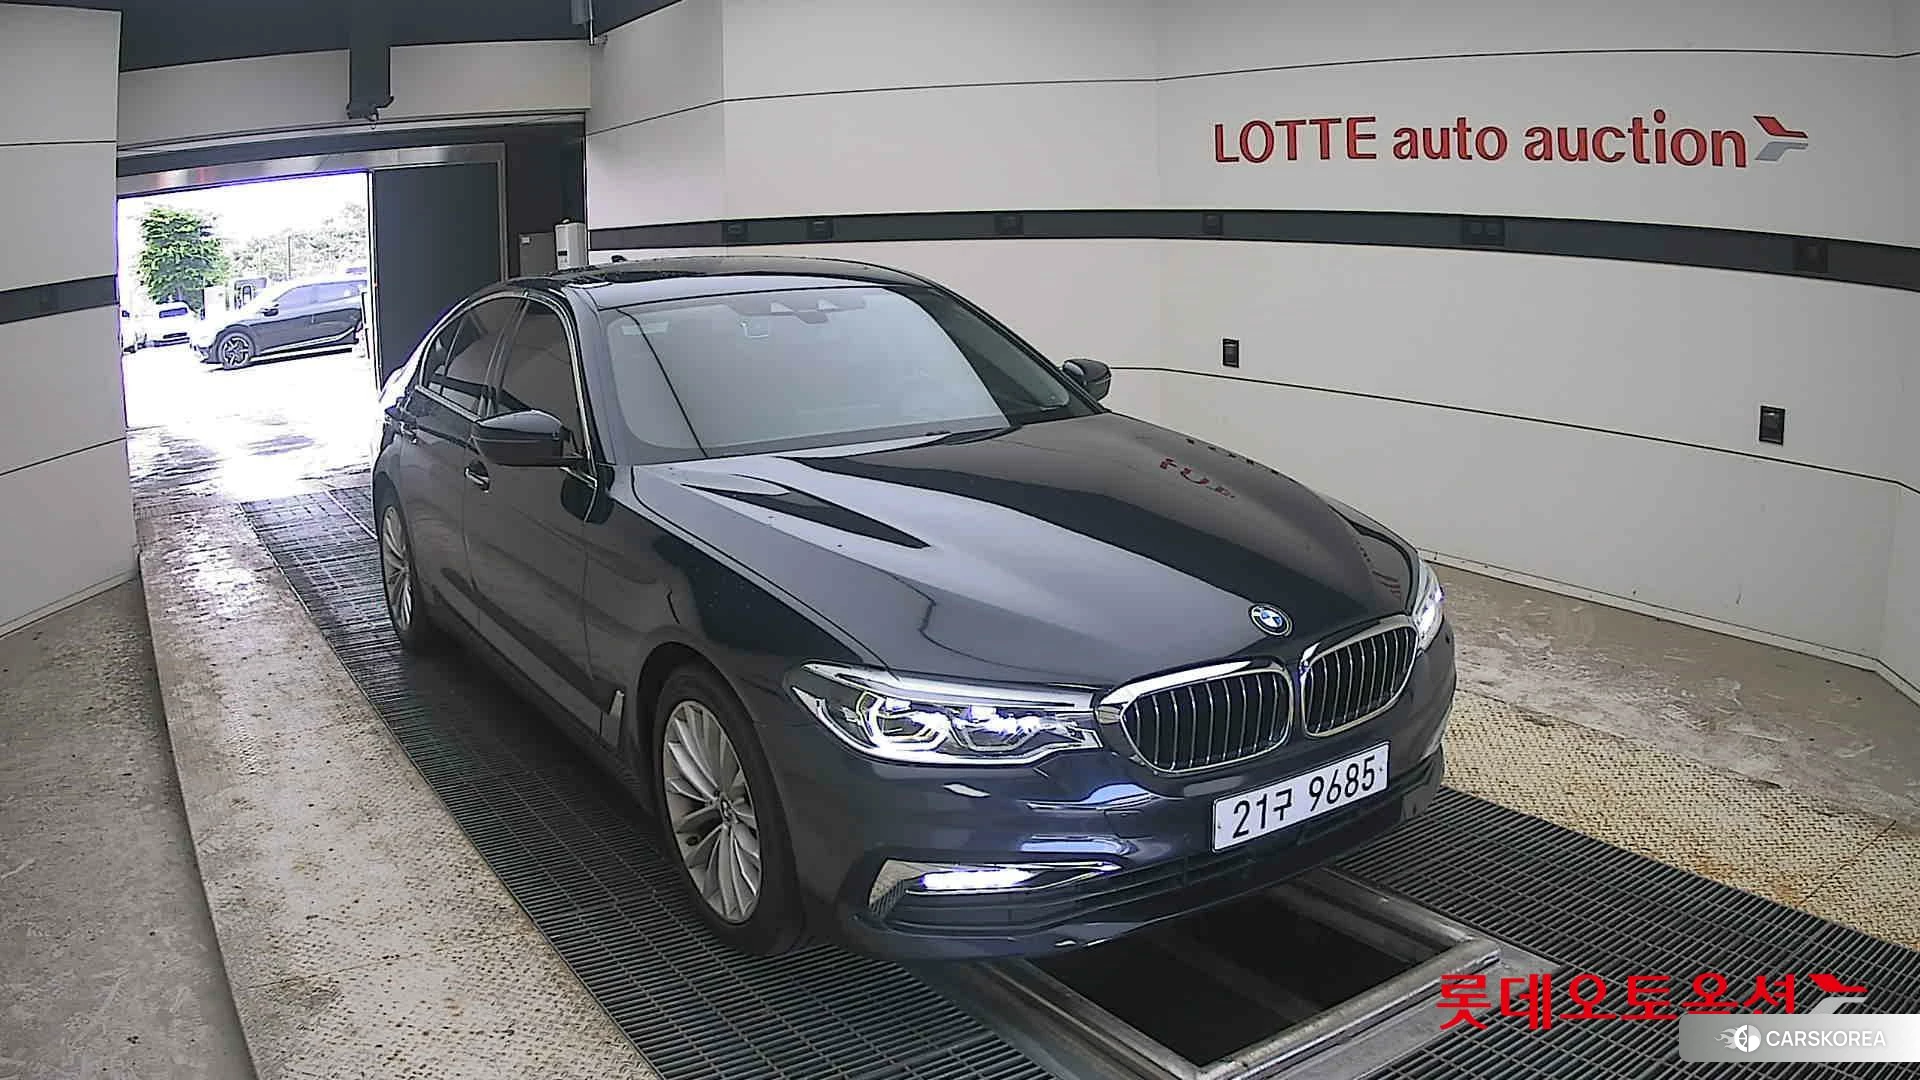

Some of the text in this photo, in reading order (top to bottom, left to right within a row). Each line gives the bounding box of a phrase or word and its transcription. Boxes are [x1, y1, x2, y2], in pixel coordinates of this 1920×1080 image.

[1214, 108, 1747, 168] LOTTE auto auction
[1232, 755, 1376, 839] 21구 9685
